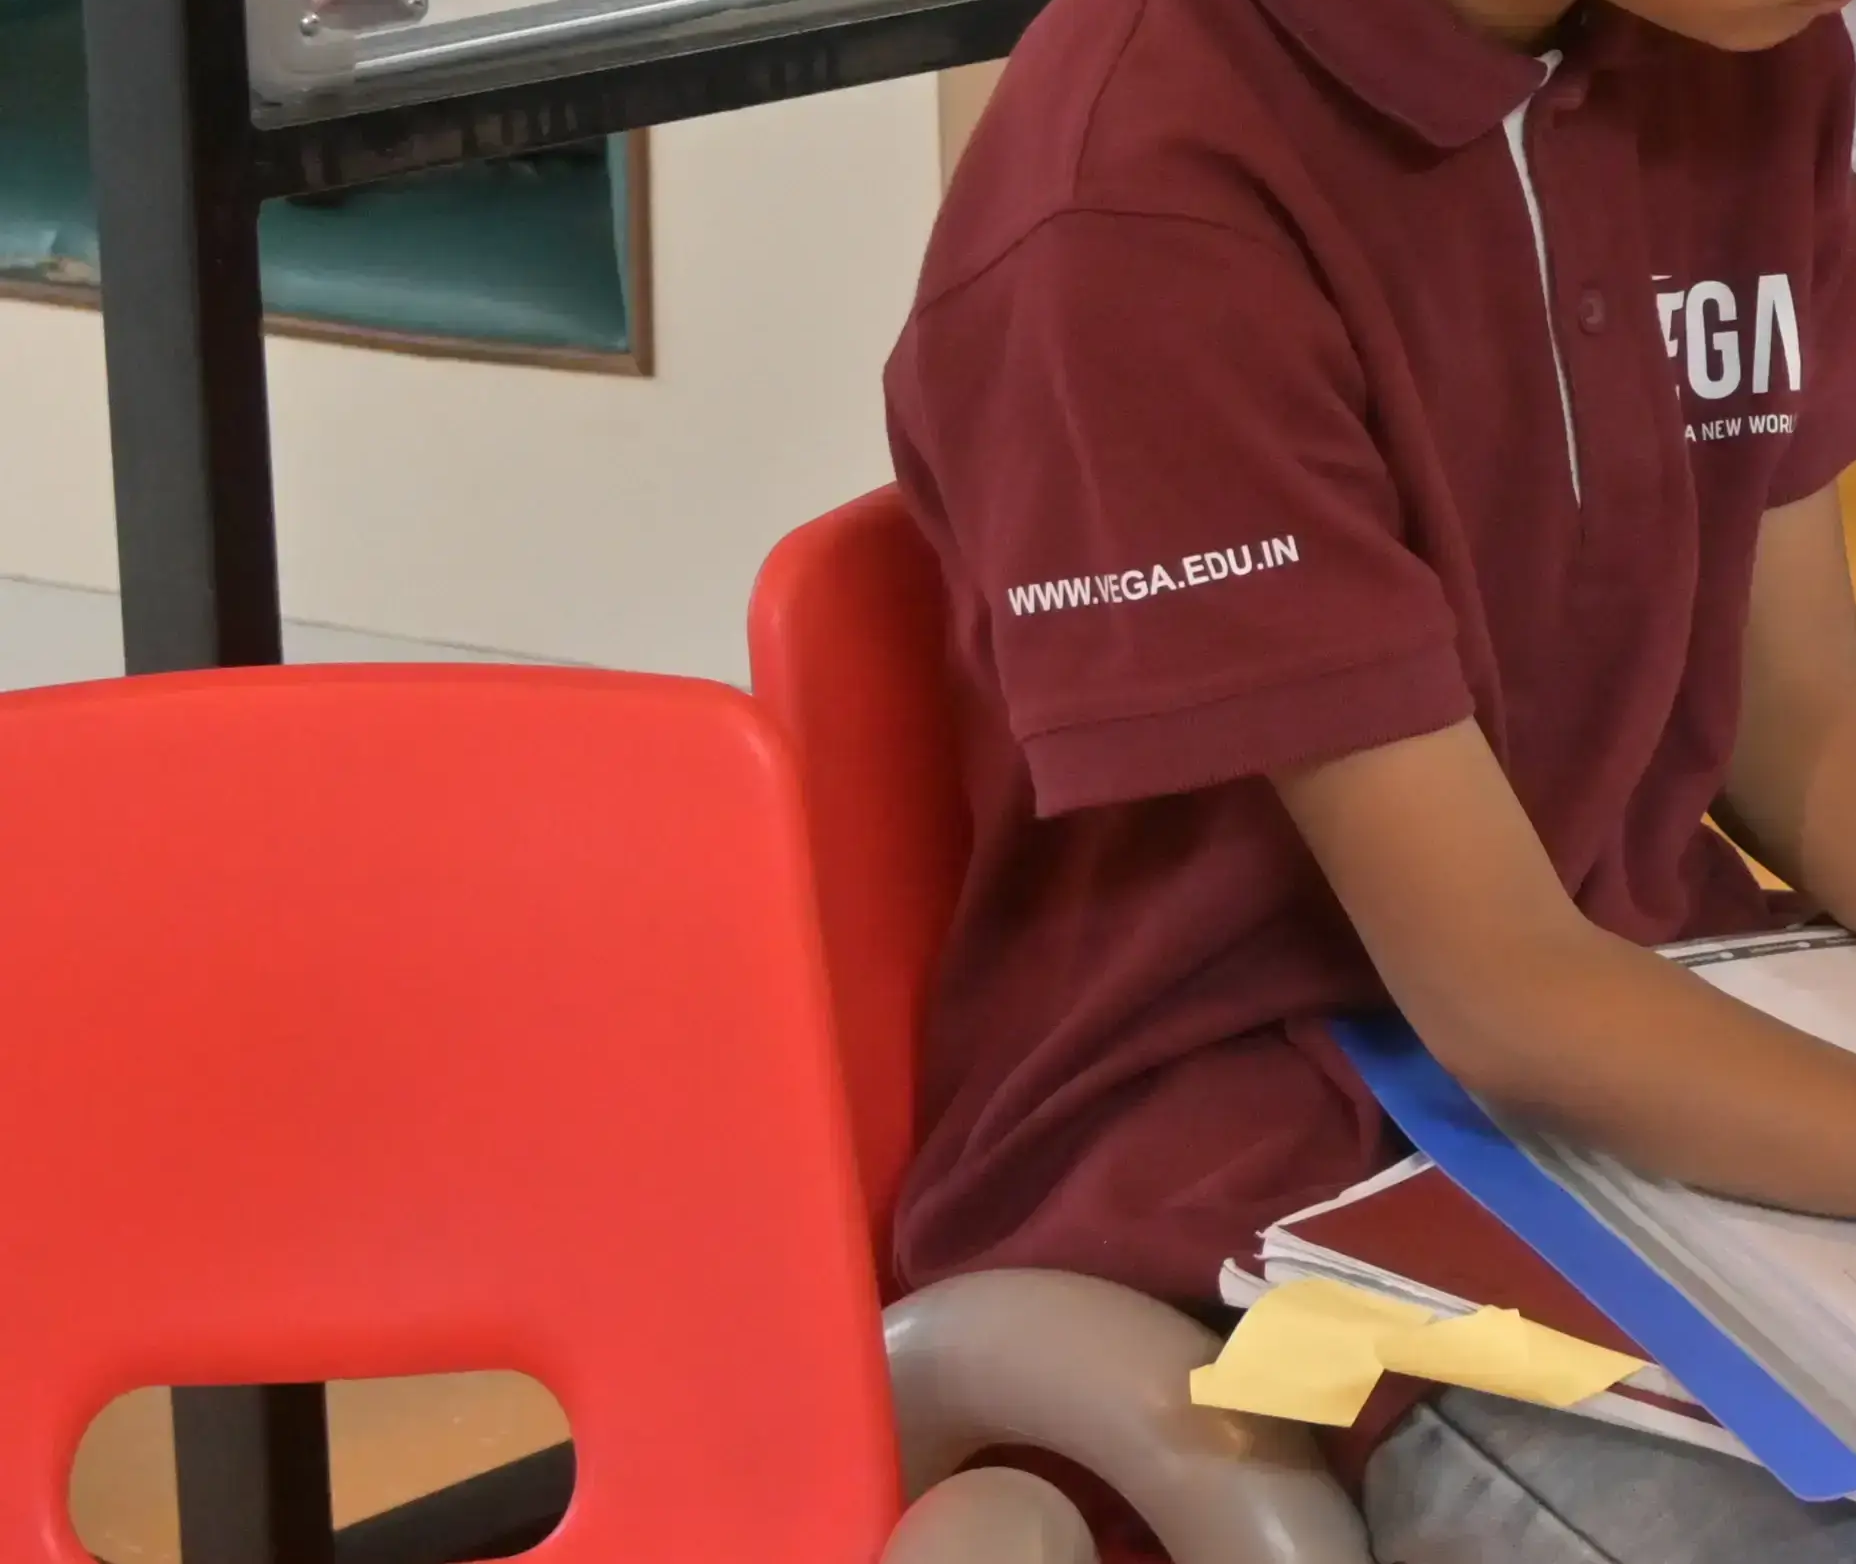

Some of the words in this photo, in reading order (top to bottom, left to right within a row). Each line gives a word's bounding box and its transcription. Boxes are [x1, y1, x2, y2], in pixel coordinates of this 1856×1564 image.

[1650, 273, 1802, 400] EGA
[1684, 423, 1698, 443] A
[1701, 416, 1743, 442] NEW
[1006, 533, 1301, 617] WWW.VEGA.EDU.IN
